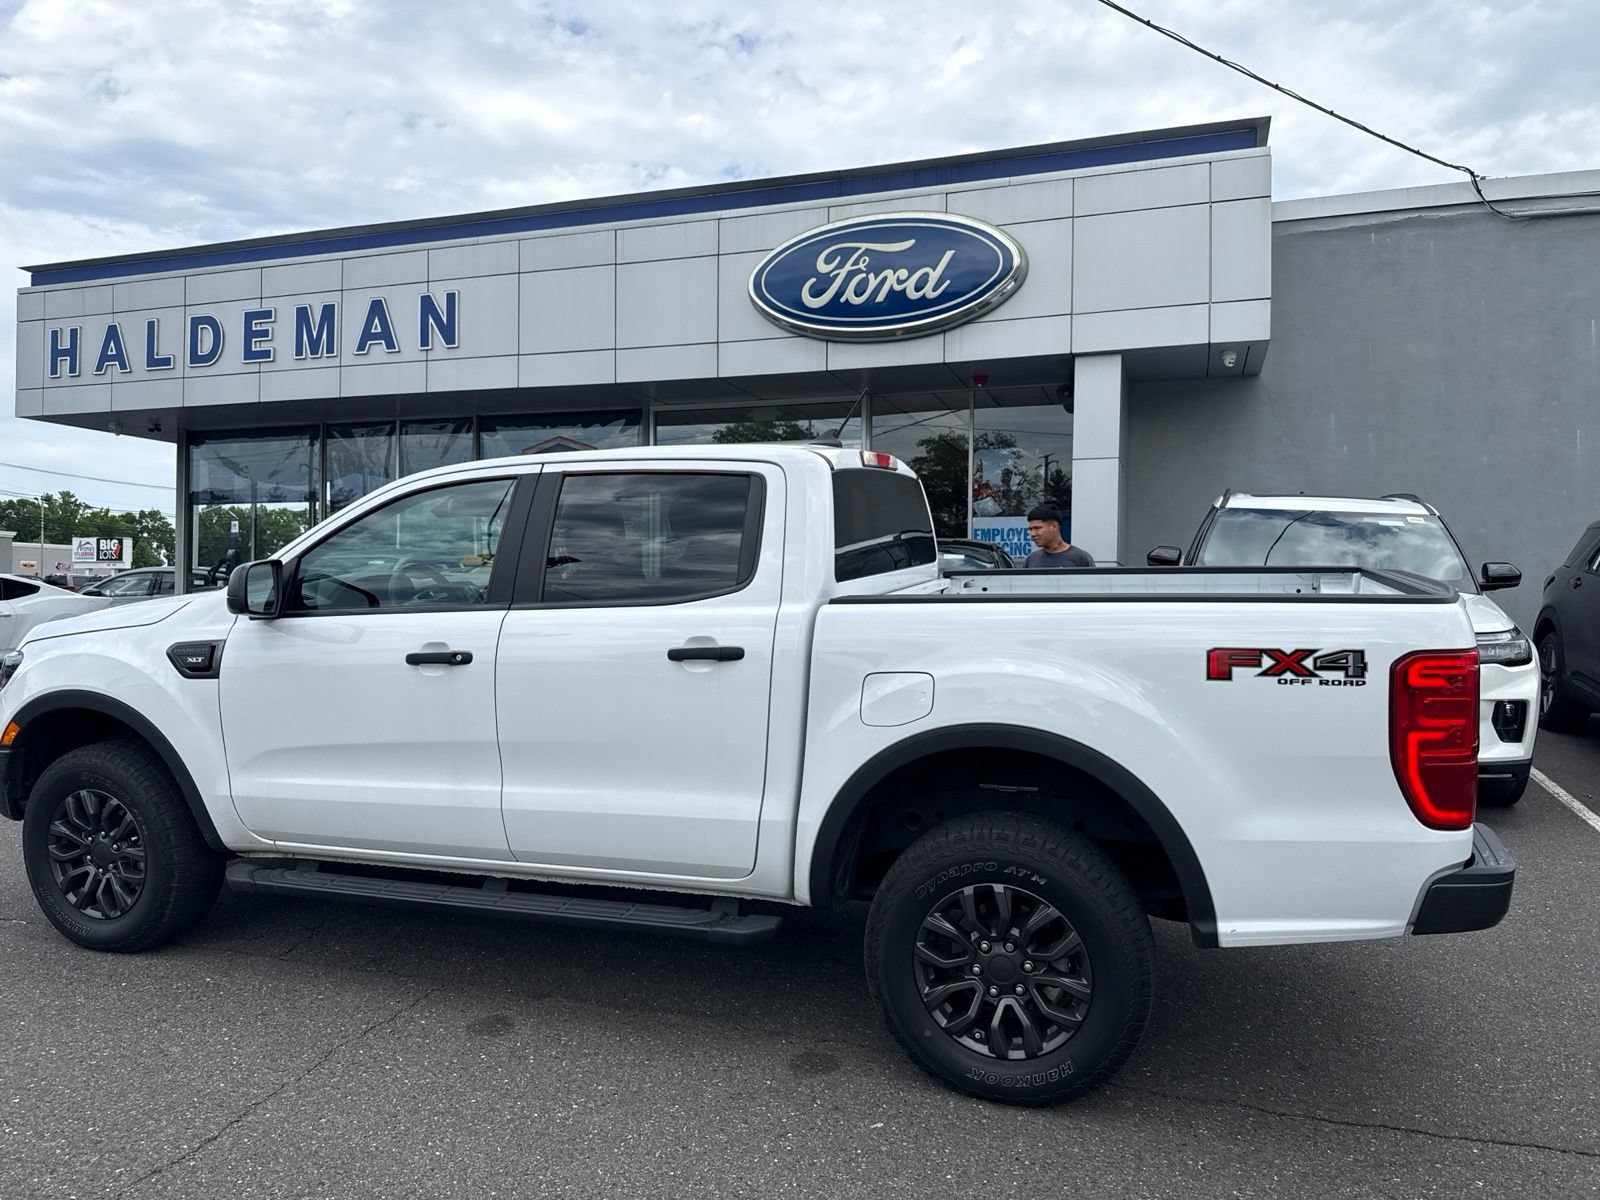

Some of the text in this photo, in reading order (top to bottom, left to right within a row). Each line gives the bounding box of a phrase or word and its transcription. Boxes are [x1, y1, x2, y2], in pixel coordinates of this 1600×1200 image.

[801, 239, 955, 308] Ford
[48, 290, 459, 378] HALDEMAN
[99, 539, 118, 550] BIG
[974, 528, 1032, 541] EMPLOYE
[1206, 647, 1368, 681] FX4
[1277, 678, 1367, 687] OFF ROAD
